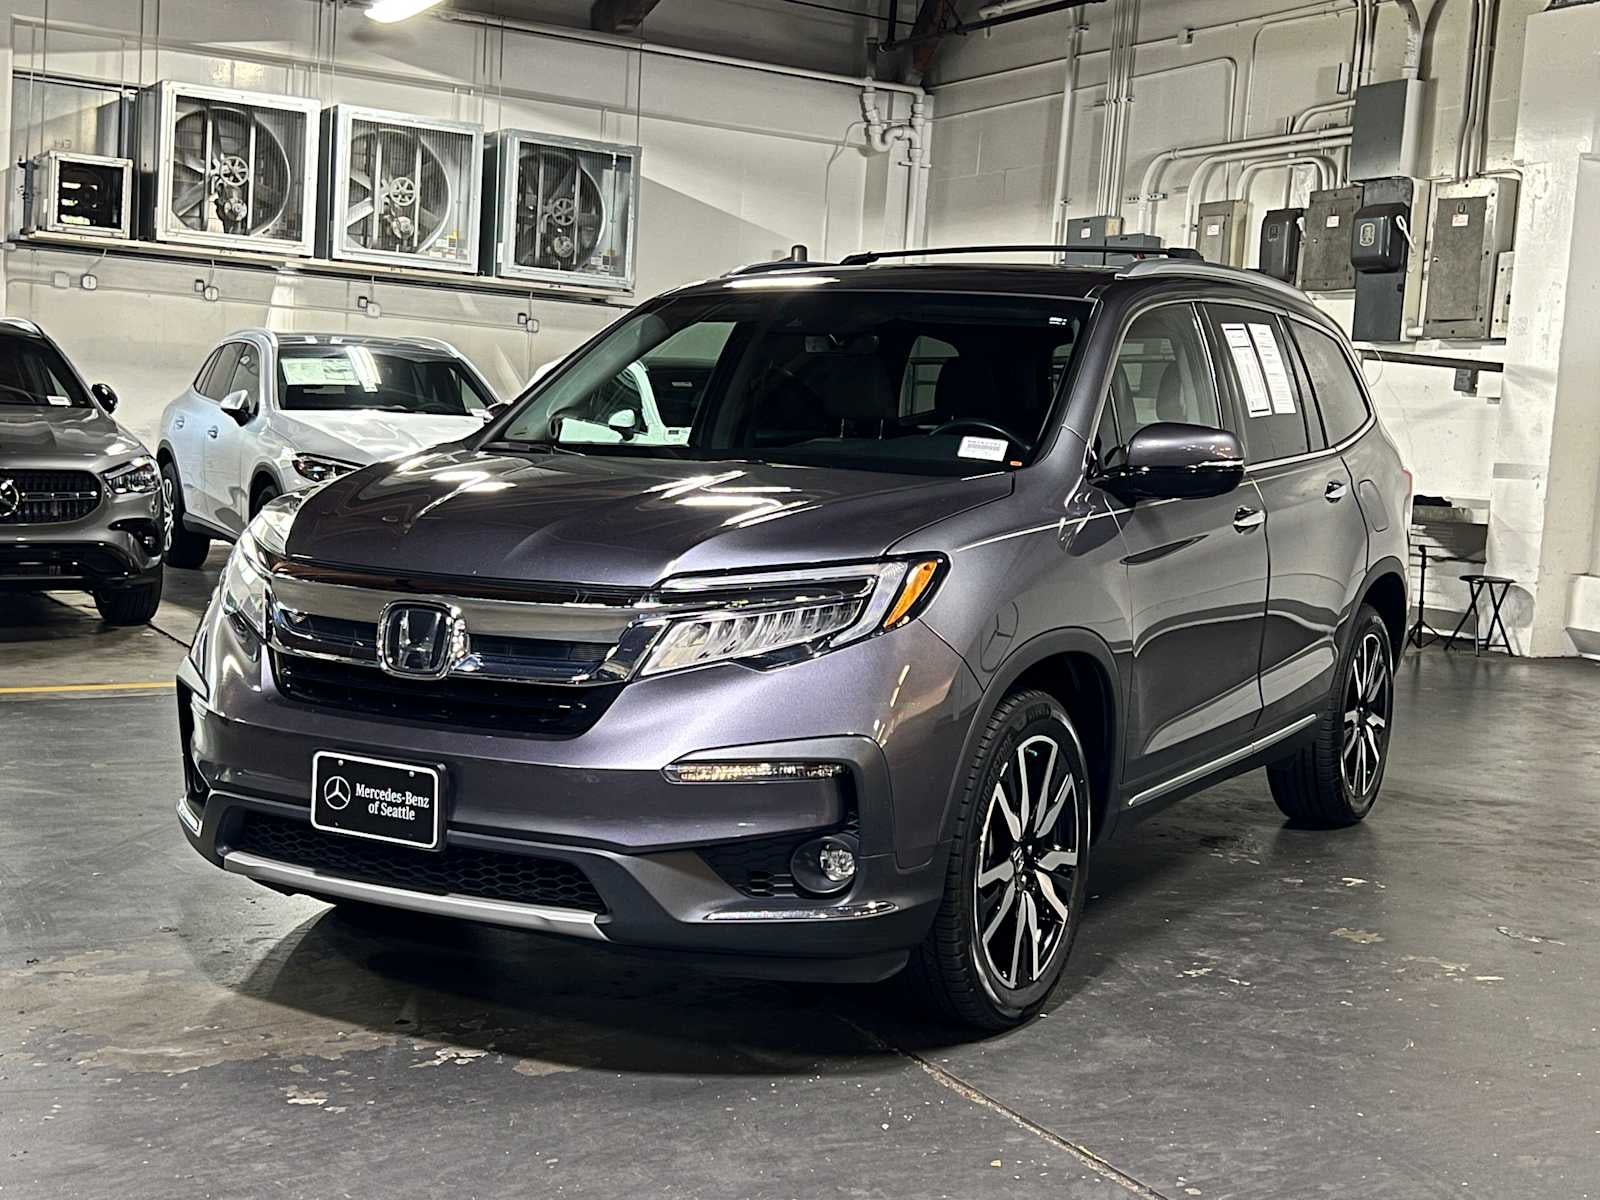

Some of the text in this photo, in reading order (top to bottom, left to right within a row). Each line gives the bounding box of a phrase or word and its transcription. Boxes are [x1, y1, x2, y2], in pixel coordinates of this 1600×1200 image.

[355, 782, 430, 808] Mercedes-Benz
[368, 801, 416, 820] of Seattle
